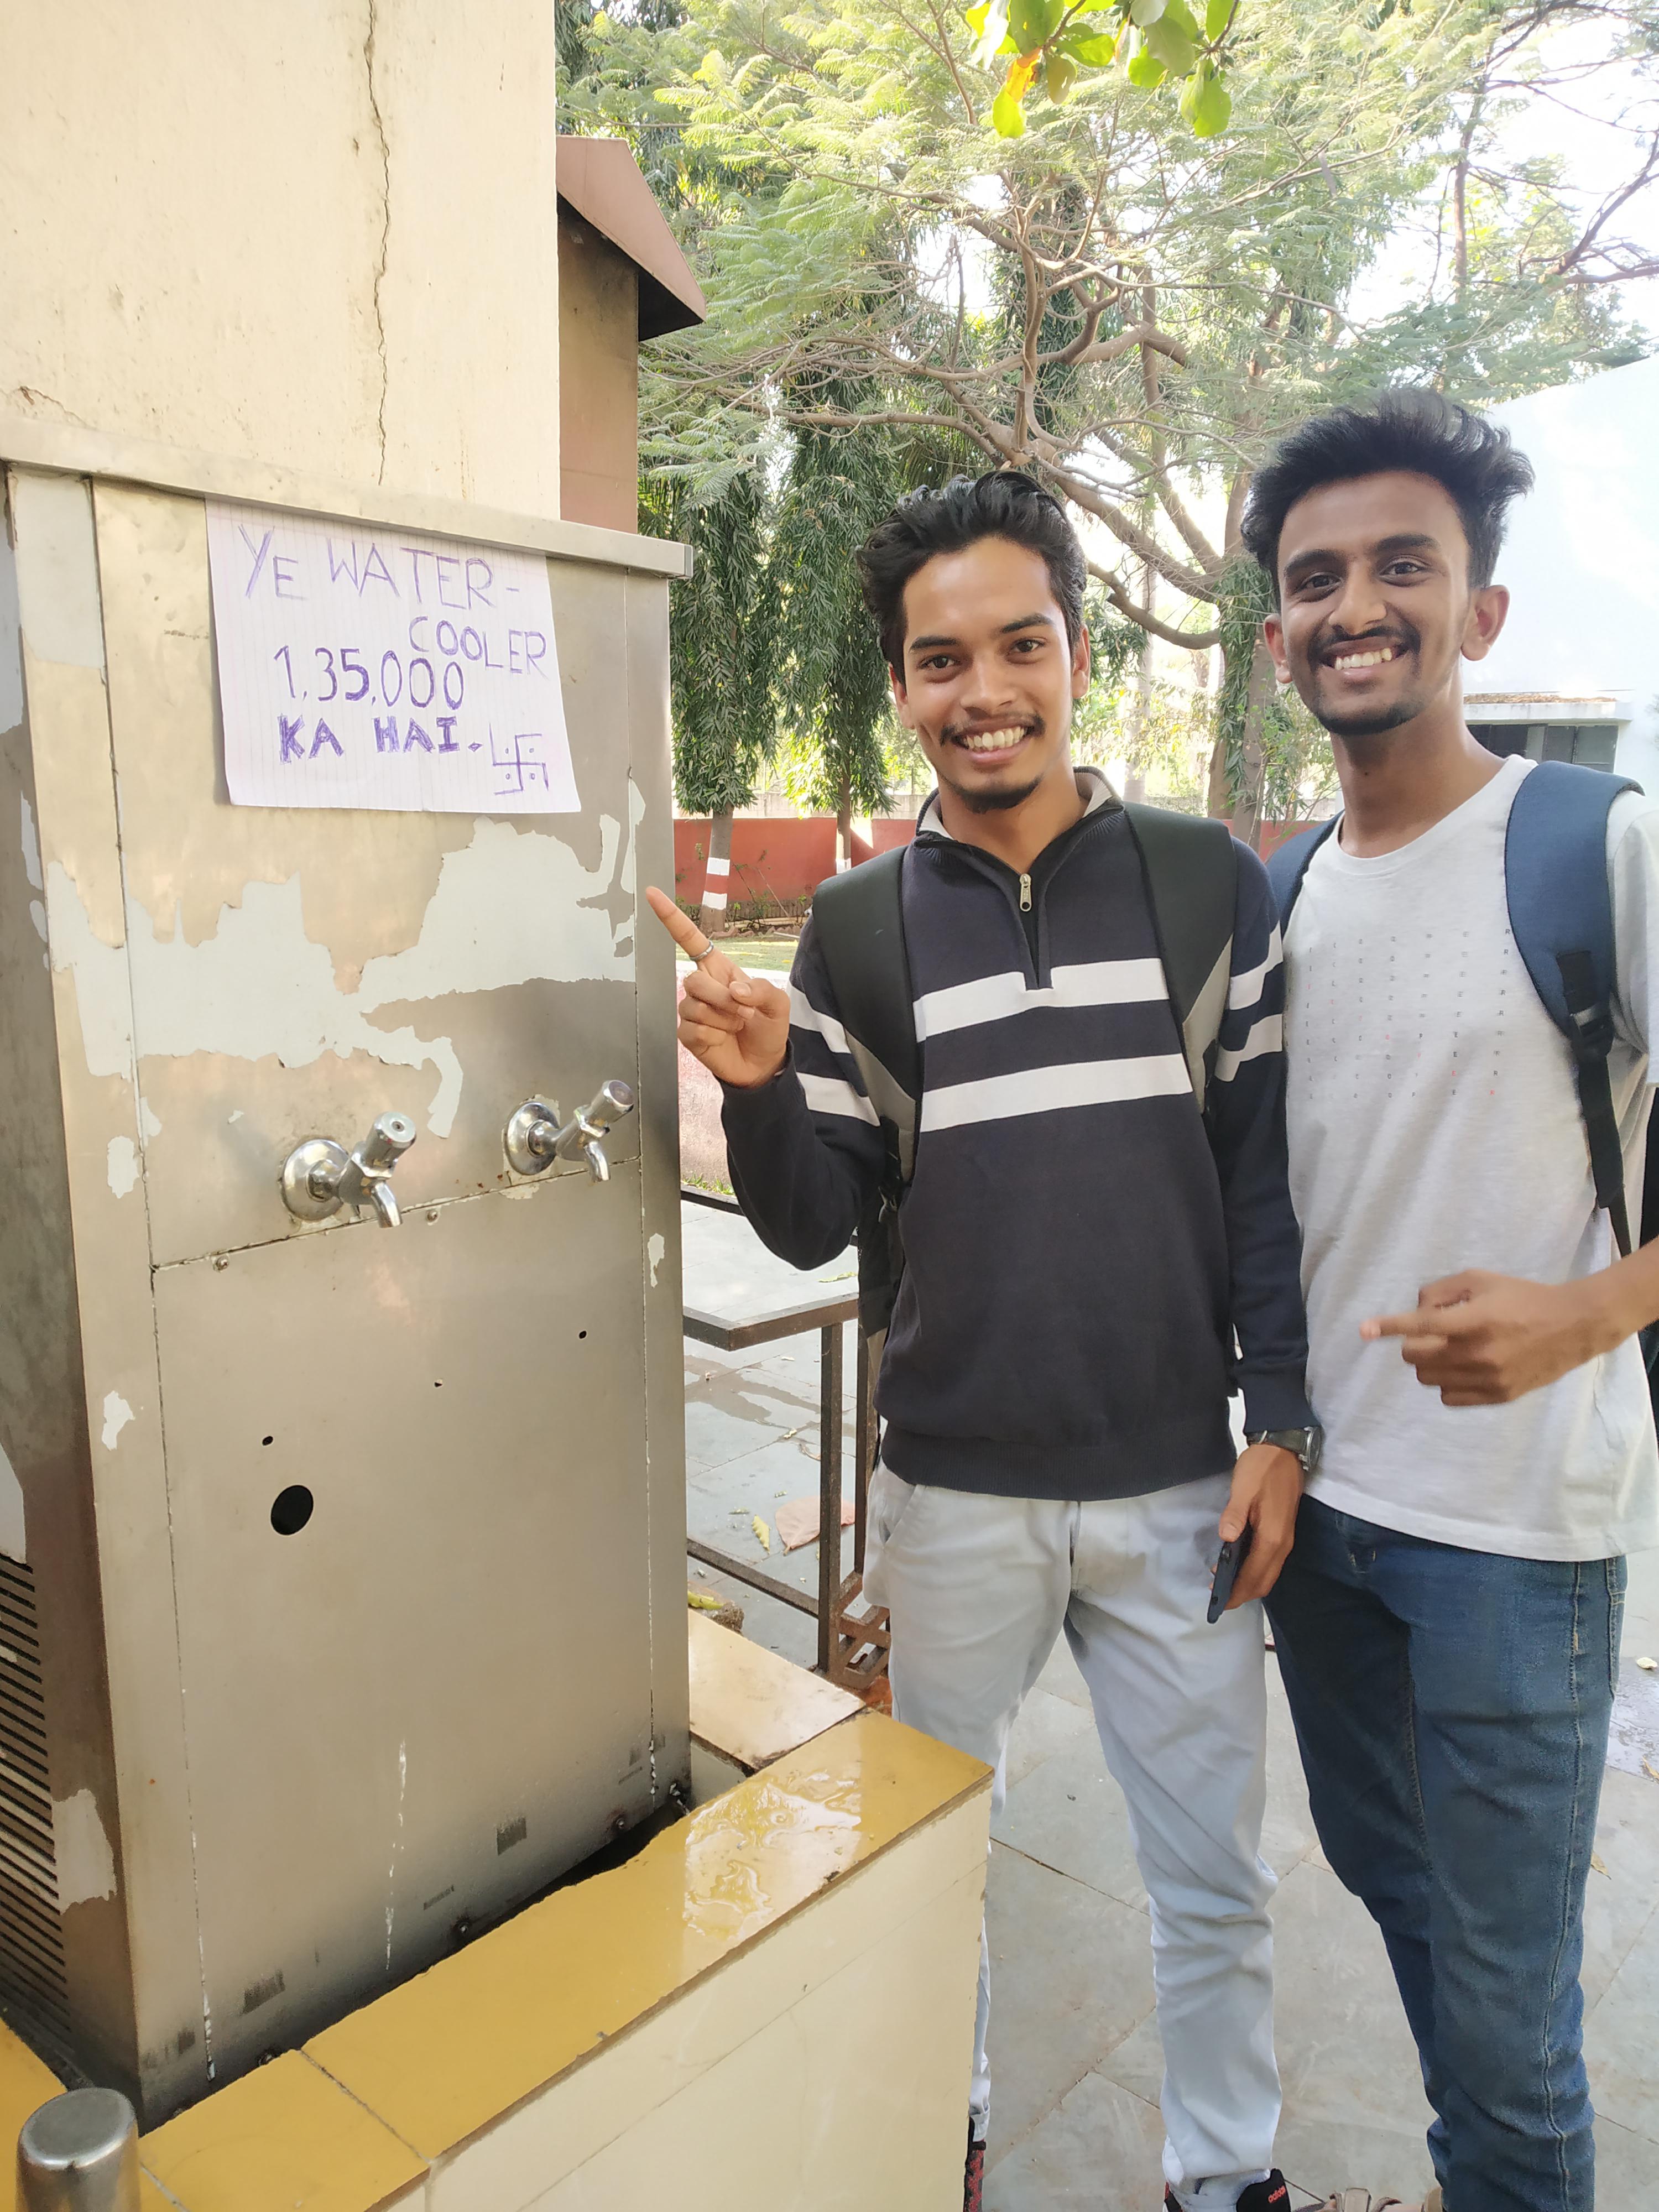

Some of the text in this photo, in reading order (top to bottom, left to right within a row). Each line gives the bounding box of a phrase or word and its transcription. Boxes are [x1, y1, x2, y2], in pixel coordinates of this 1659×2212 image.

[238, 524, 306, 599] YE
[409, 615, 548, 680] COOLER
[277, 714, 344, 764] KA
